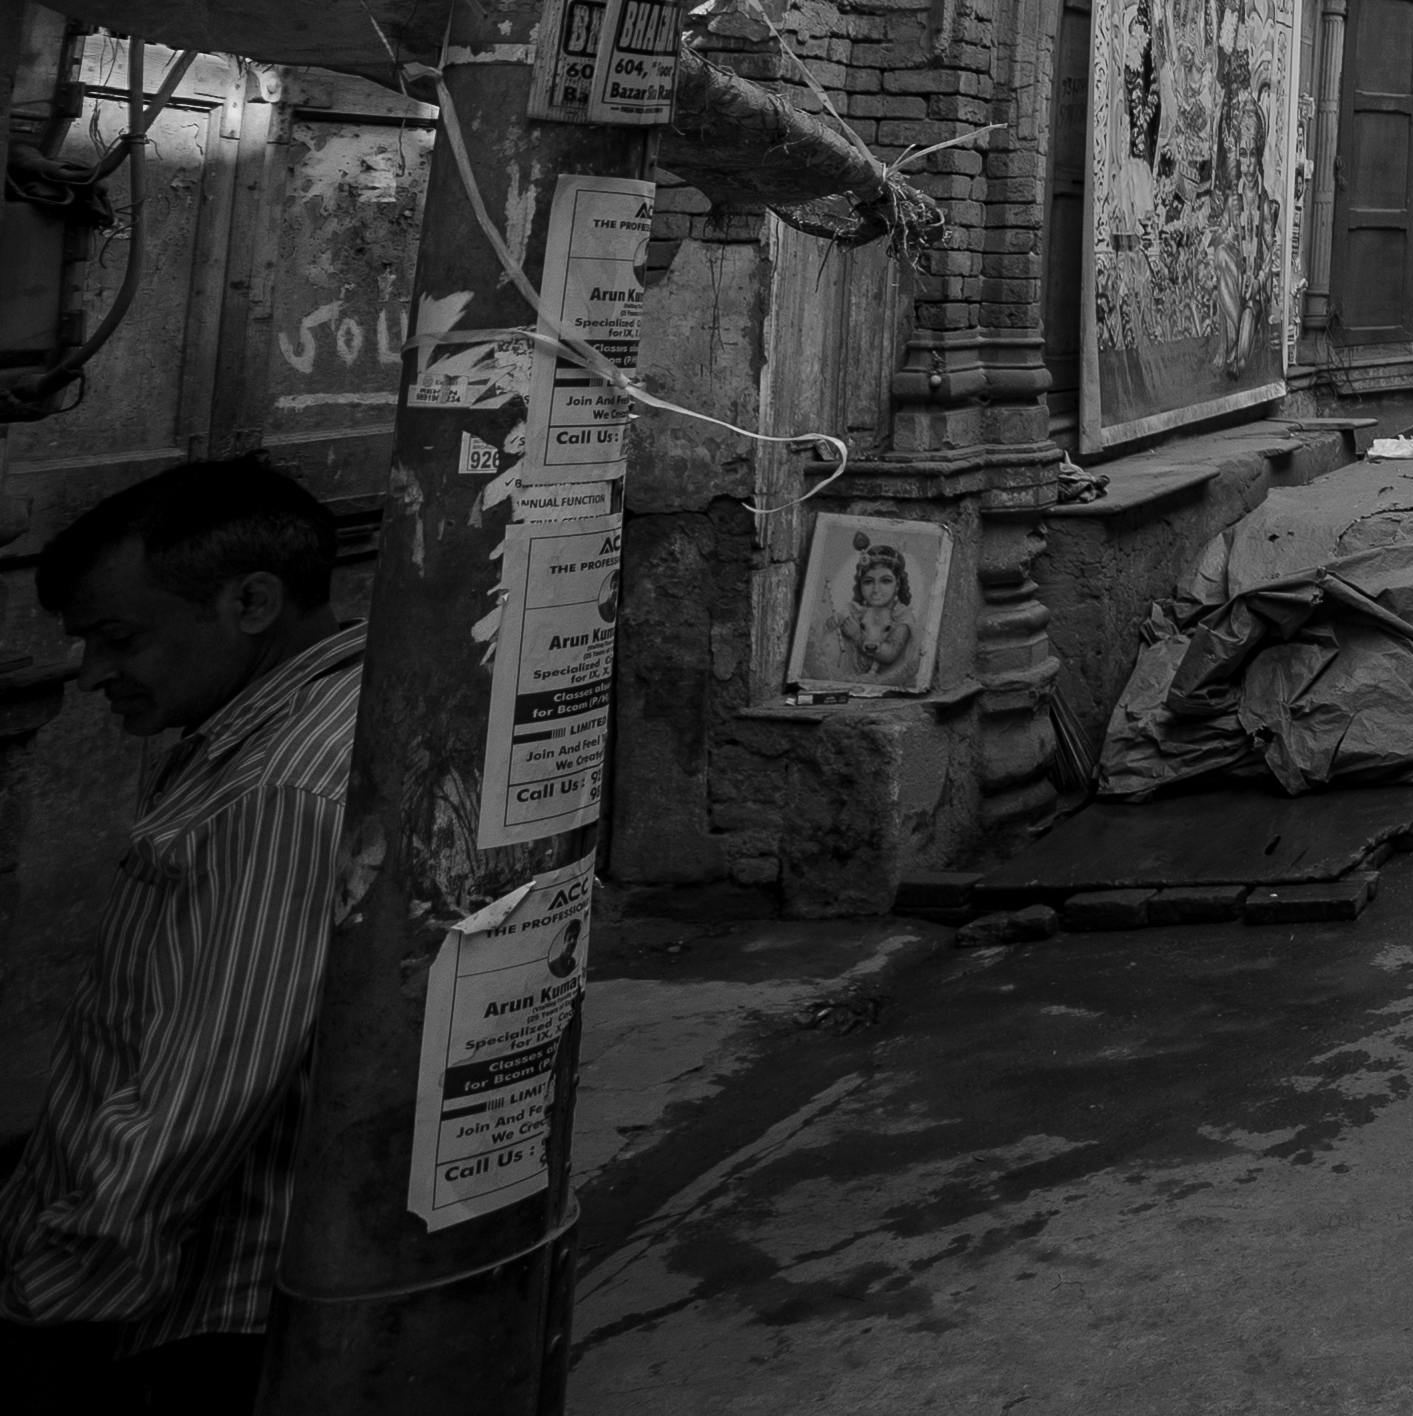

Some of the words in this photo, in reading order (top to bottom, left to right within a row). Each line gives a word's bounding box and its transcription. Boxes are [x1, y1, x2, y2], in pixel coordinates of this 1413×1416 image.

[615, 58, 648, 79] 604,
[610, 82, 647, 100] Bazar
[593, 219, 617, 229] THE
[590, 287, 625, 303] Arun
[575, 317, 635, 330] Specialized
[609, 328, 623, 338] for
[566, 396, 593, 407] Join
[595, 396, 614, 407] And
[593, 410, 610, 420] We
[556, 430, 591, 445] Call
[561, 494, 606, 507] FUNCTION
[550, 563, 577, 575] THE
[550, 632, 589, 651] Arun
[533, 660, 600, 681] Specialized
[571, 671, 586, 684] for
[553, 687, 593, 703] Classes
[532, 708, 554, 720] for
[557, 702, 588, 715] Bcom
[526, 749, 555, 763] Join
[558, 742, 581, 756] And
[555, 760, 573, 772] We
[517, 784, 554, 803] Call
[547, 877, 588, 911] ACC
[485, 924, 516, 939] THE
[484, 995, 534, 1019] Arun
[464, 1020, 553, 1051] Specialized
[510, 1037, 534, 1051] for
[488, 1049, 544, 1073] Classes
[463, 1079, 489, 1092] for
[493, 1067, 536, 1084] Bcom
[456, 1122, 490, 1139] Join
[495, 1109, 525, 1130] And
[491, 1129, 515, 1145] We
[444, 1155, 491, 1182] Call
